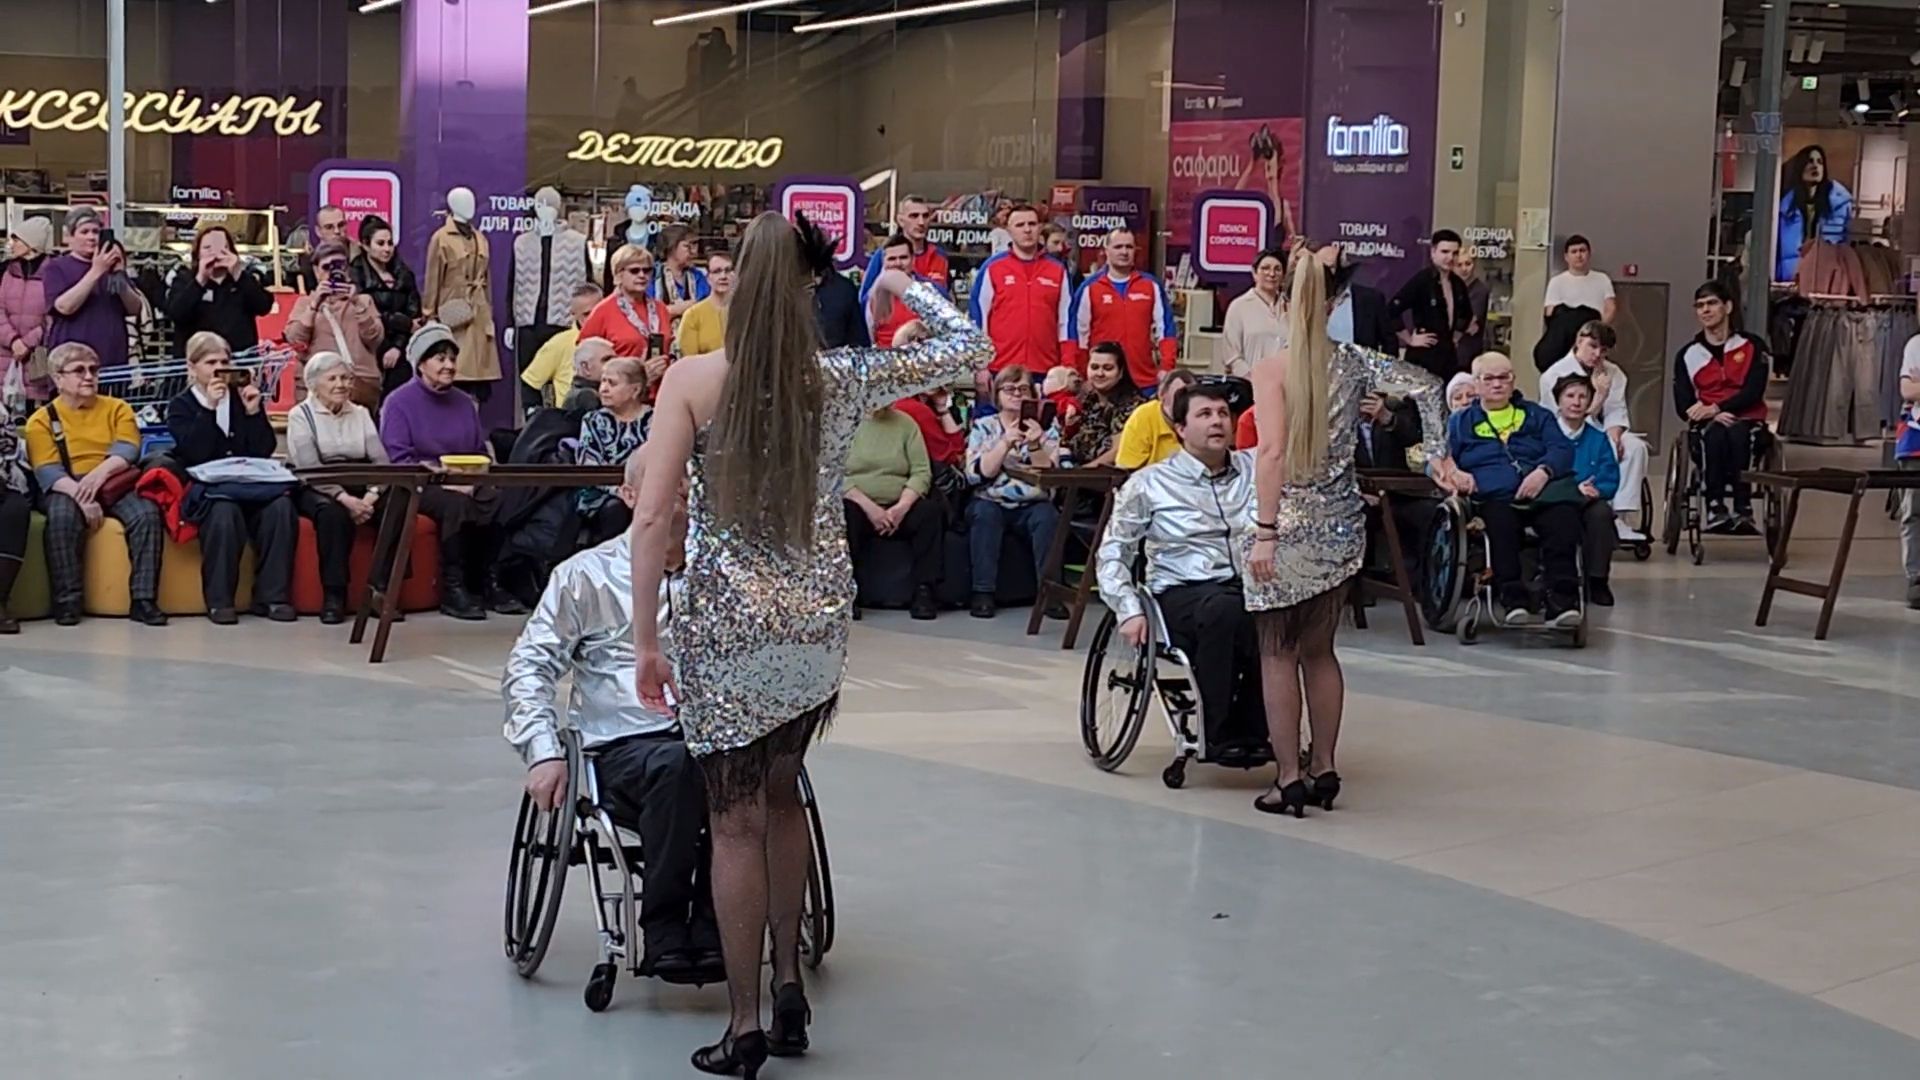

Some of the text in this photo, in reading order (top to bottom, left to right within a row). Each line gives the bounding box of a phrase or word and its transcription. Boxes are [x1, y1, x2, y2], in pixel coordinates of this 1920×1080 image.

[1327, 114, 1409, 156] familia
[568, 131, 783, 169] ДЕТСТВО
[1173, 147, 1240, 187] сафари
[172, 185, 221, 200] familia
[479, 216, 510, 233] ДЛЯ
[937, 209, 989, 225] ТОВАРЫ
[1071, 215, 1127, 230] ОДЕЖДА
[927, 229, 954, 244] ДЛЯ
[1339, 222, 1388, 237] ТОВАРЫ
[1463, 227, 1514, 242] ОДЕЖДА
[1078, 234, 1107, 249] ОБУ
